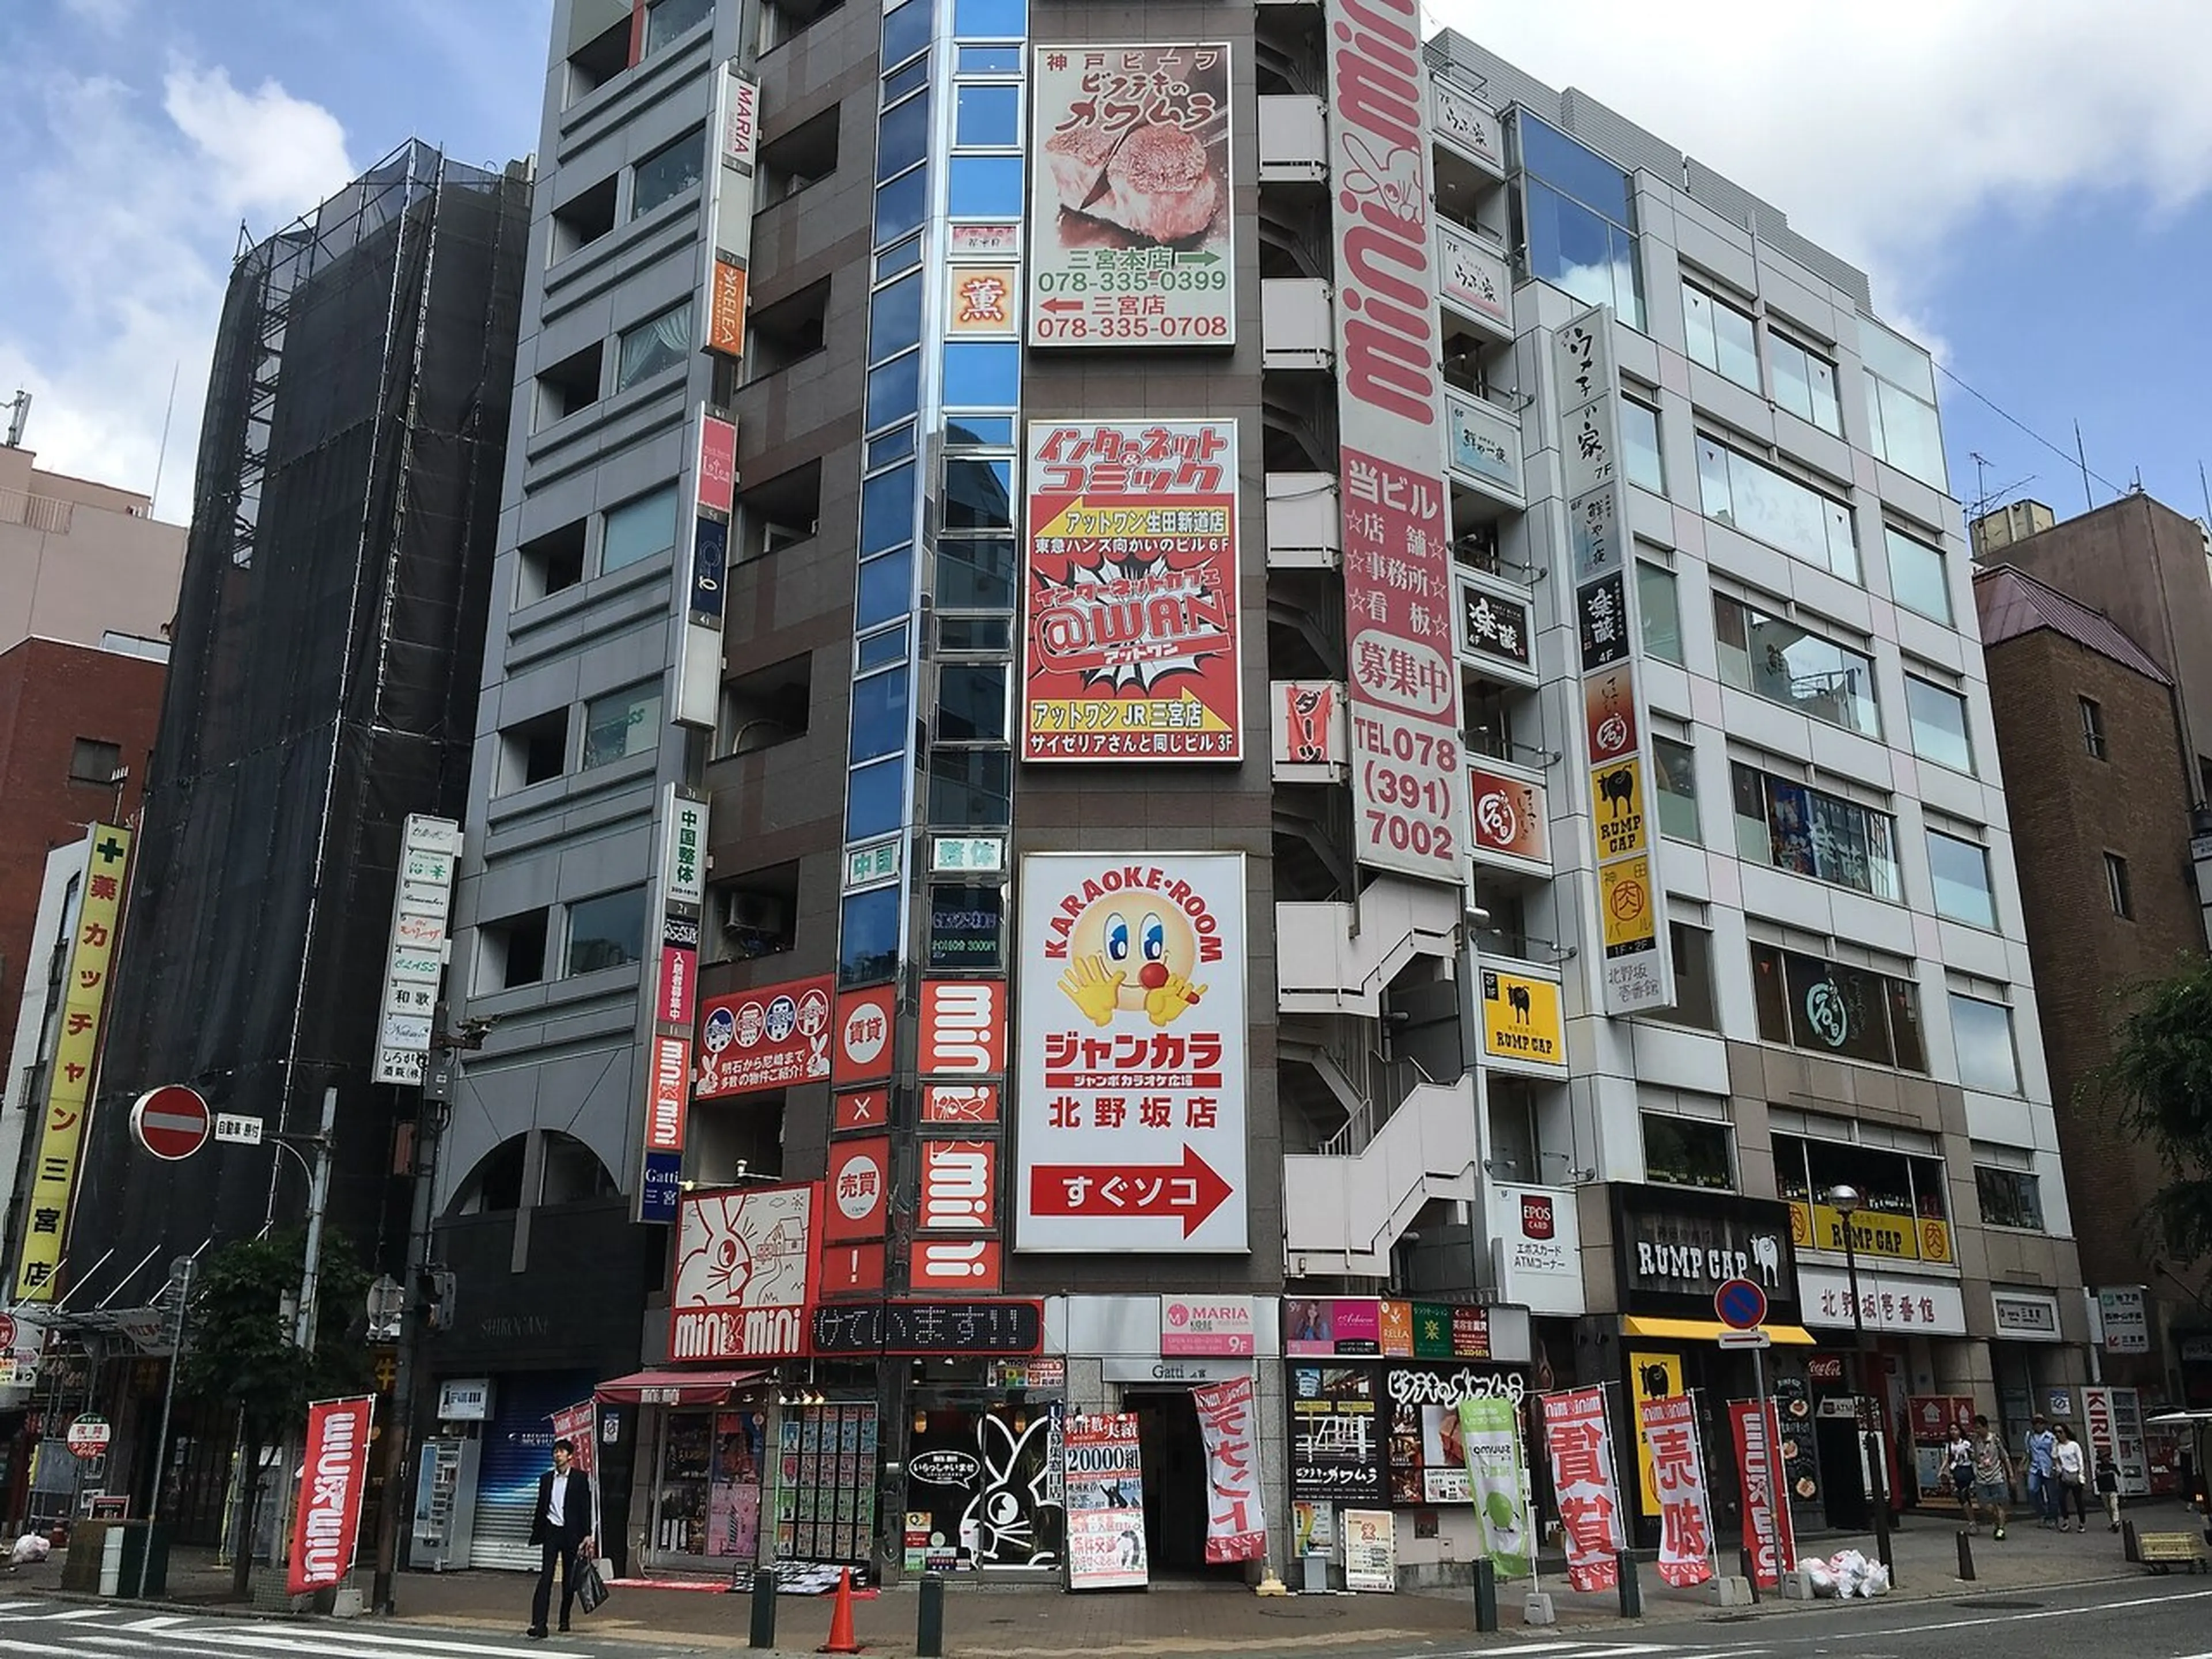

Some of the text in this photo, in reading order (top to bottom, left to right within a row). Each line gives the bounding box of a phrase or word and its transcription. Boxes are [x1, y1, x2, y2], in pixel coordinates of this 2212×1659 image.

[1047, 52, 1218, 70] 神戸ビーフ
[1082, 72, 1189, 99] ビフテキの
[734, 86, 753, 153] MARIA
[1055, 94, 1217, 132] カワムラ
[1067, 249, 1173, 270] 三宮本店
[1038, 270, 1226, 292] 078-335-0399
[1092, 296, 1166, 316] 三宮店
[1037, 317, 1228, 339] 078-335-0708
[1036, 428, 1228, 461] インターネット
[1039, 464, 1224, 494] コミック
[1595, 463, 1612, 479] 7F
[1350, 459, 1438, 520] 当ビル
[1067, 512, 1225, 534] アットワン生田新道店
[1366, 551, 1427, 598] 事務所
[1036, 569, 1222, 607] インターネットカフェ
[1469, 597, 1518, 656] 楽蔵
[1104, 644, 1179, 664] アットワン
[1358, 641, 1448, 705] 募集中
[1365, 760, 1450, 820] (391)
[1366, 810, 1453, 860] 7002
[1600, 814, 1641, 840] RUMP
[676, 810, 698, 884] 中国整体
[1609, 833, 1636, 854] CAP
[1609, 963, 1648, 984] 北野坂
[849, 1016, 881, 1046] 賃貸
[1497, 1031, 1529, 1051] RUMP
[1045, 1033, 1222, 1069] ジャンカラ
[1531, 1037, 1553, 1054] CAP
[721, 1050, 805, 1075] 明石から尼崎まで
[1074, 1074, 1194, 1089] ジャンボカラオケ広場
[1050, 1096, 1218, 1128] 北野坂店
[645, 1169, 679, 1183] Gatti
[840, 1172, 877, 1199] 売買
[1063, 1177, 1196, 1208] すぐソコ
[1524, 1206, 1551, 1220] EPOS
[1528, 1221, 1548, 1230] CARD
[1831, 1222, 1872, 1251] RMP
[1875, 1230, 1902, 1253] CAP
[1517, 1243, 1562, 1256] エポスカード
[1638, 1241, 1703, 1279] RUMP
[1514, 1256, 1565, 1270] ATMコーナー
[1708, 1248, 1748, 1280] CAP
[1193, 1306, 1248, 1319] MARIA
[1228, 1336, 1247, 1353] 9F
[1152, 1364, 1184, 1379] Gatti
[914, 1463, 975, 1472] いらっしゃいませ
[1067, 1447, 1139, 1472] 20000組
